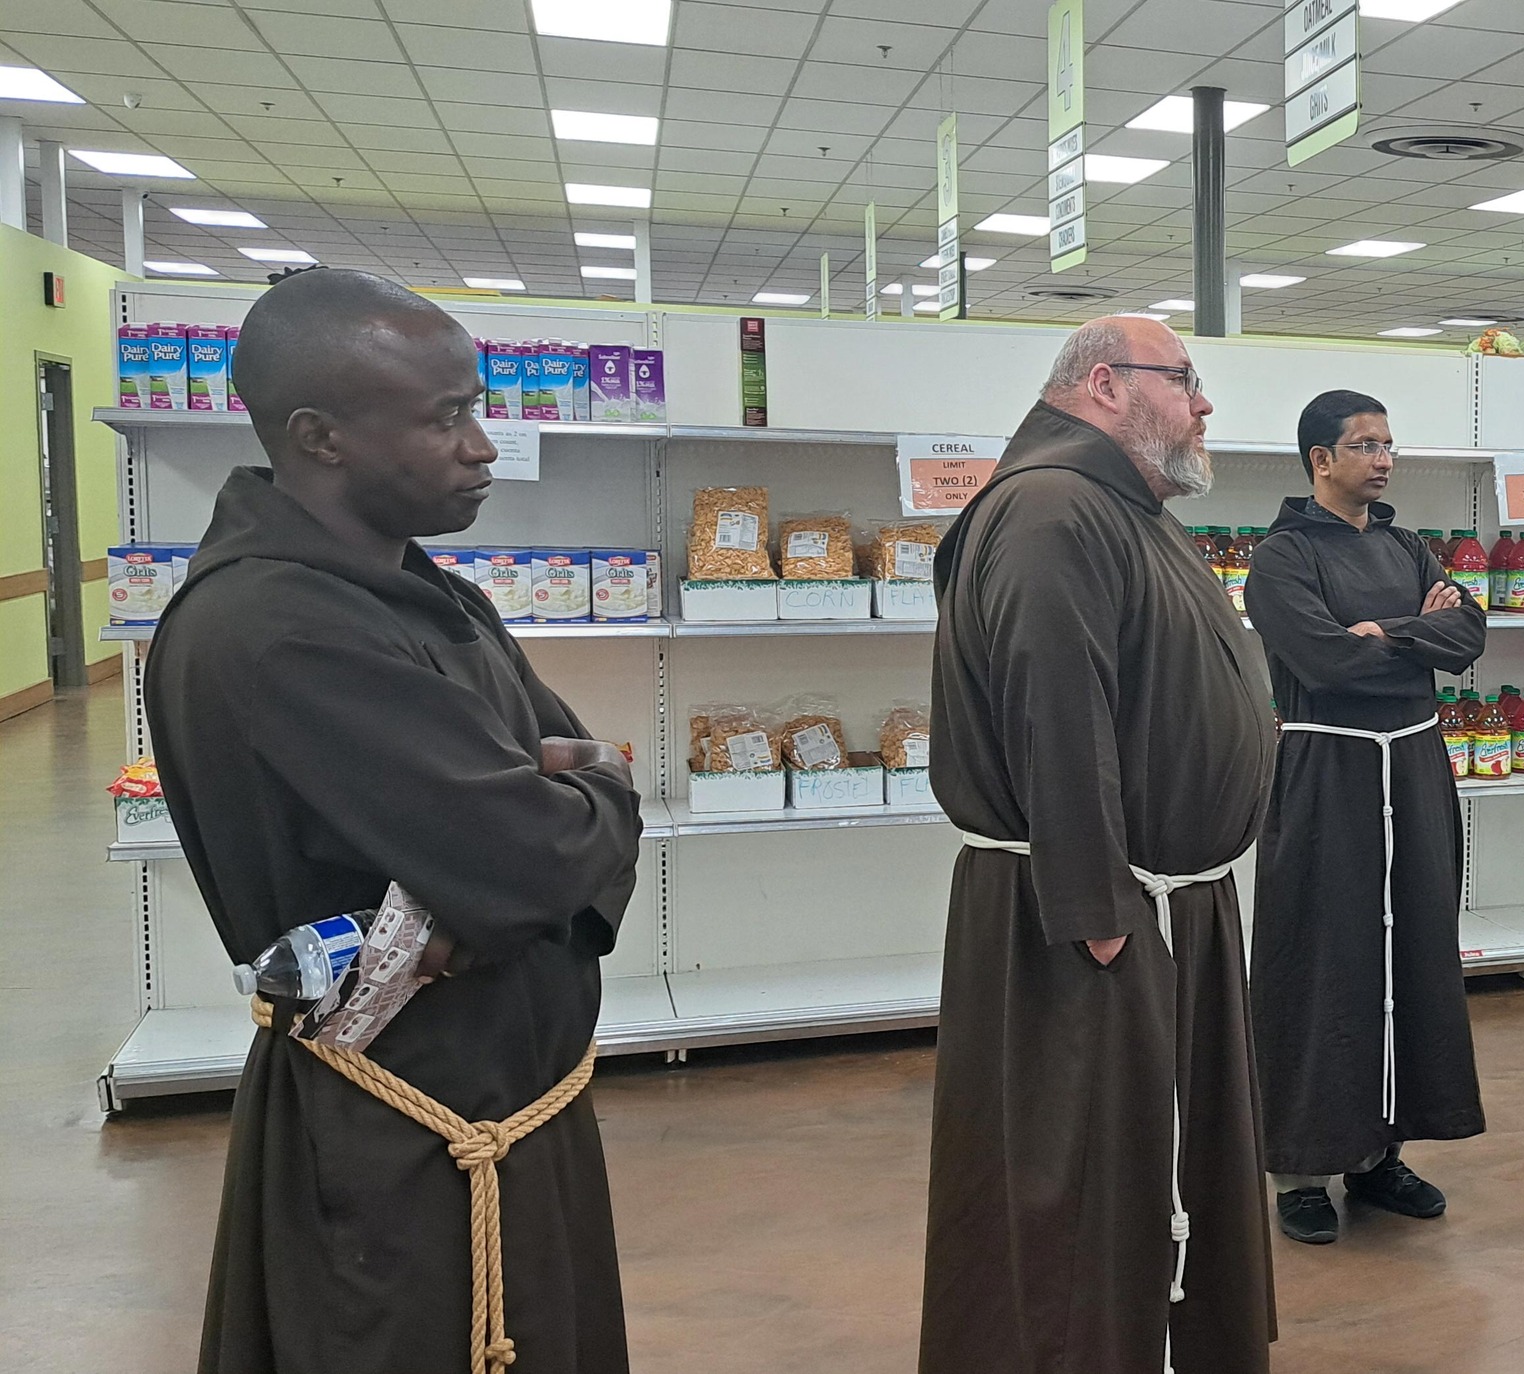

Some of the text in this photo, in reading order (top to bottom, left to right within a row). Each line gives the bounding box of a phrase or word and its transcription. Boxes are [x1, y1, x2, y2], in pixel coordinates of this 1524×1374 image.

[1057, 9, 1073, 112] 4
[1309, 90, 1328, 121] GRITS
[151, 342, 183, 355] Dairy
[191, 344, 223, 356] Dairy
[154, 352, 181, 361] Pure
[194, 353, 221, 362] Pure
[490, 358, 519, 370] Dairy
[542, 358, 570, 370] Dairy
[493, 366, 517, 376] Pure
[544, 366, 568, 376] Pure
[932, 443, 975, 453] CEREAL
[943, 461, 966, 469] LIMIT
[933, 474, 978, 487] TWO (2)
[945, 492, 968, 500] ONLY
[124, 565, 158, 577] Grits
[488, 567, 519, 579] Grits
[545, 567, 575, 579] Grits
[605, 567, 635, 579] Grits
[785, 591, 854, 608] CORN
[1480, 741, 1508, 756] Everfresh
